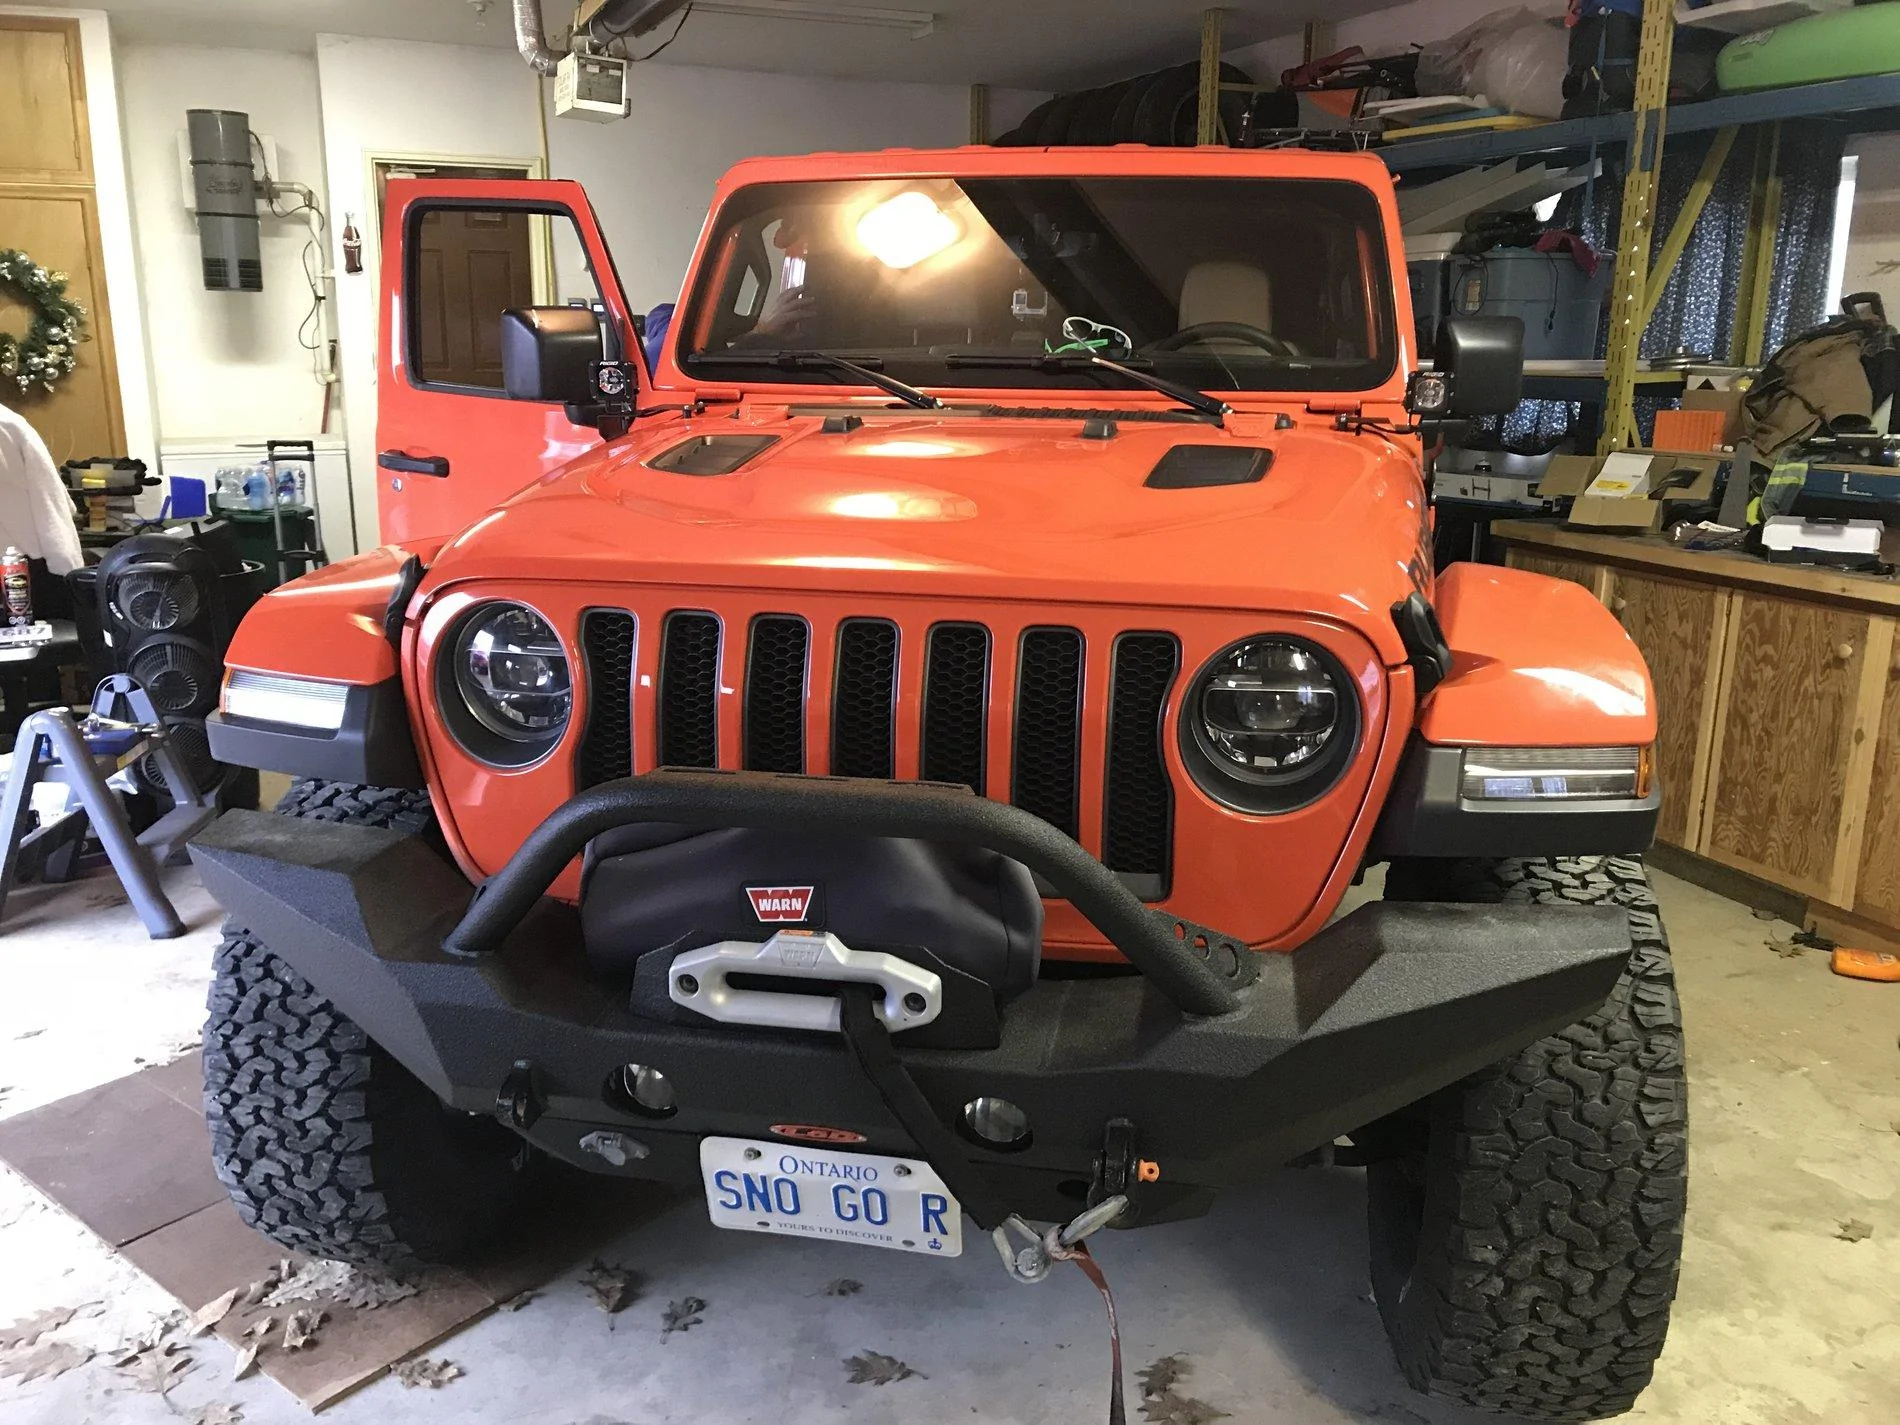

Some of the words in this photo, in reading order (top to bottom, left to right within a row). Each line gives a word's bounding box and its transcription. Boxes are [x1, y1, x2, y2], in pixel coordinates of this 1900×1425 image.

[758, 898, 802, 911] WARN
[779, 1155, 878, 1182] ONTARIO
[714, 1169, 801, 1216] SNO
[832, 1184, 889, 1226] GO
[920, 1193, 949, 1236] R
[777, 1221, 815, 1232] YOURS
[819, 1225, 833, 1234] TO
[836, 1229, 893, 1242] DISCOVER
